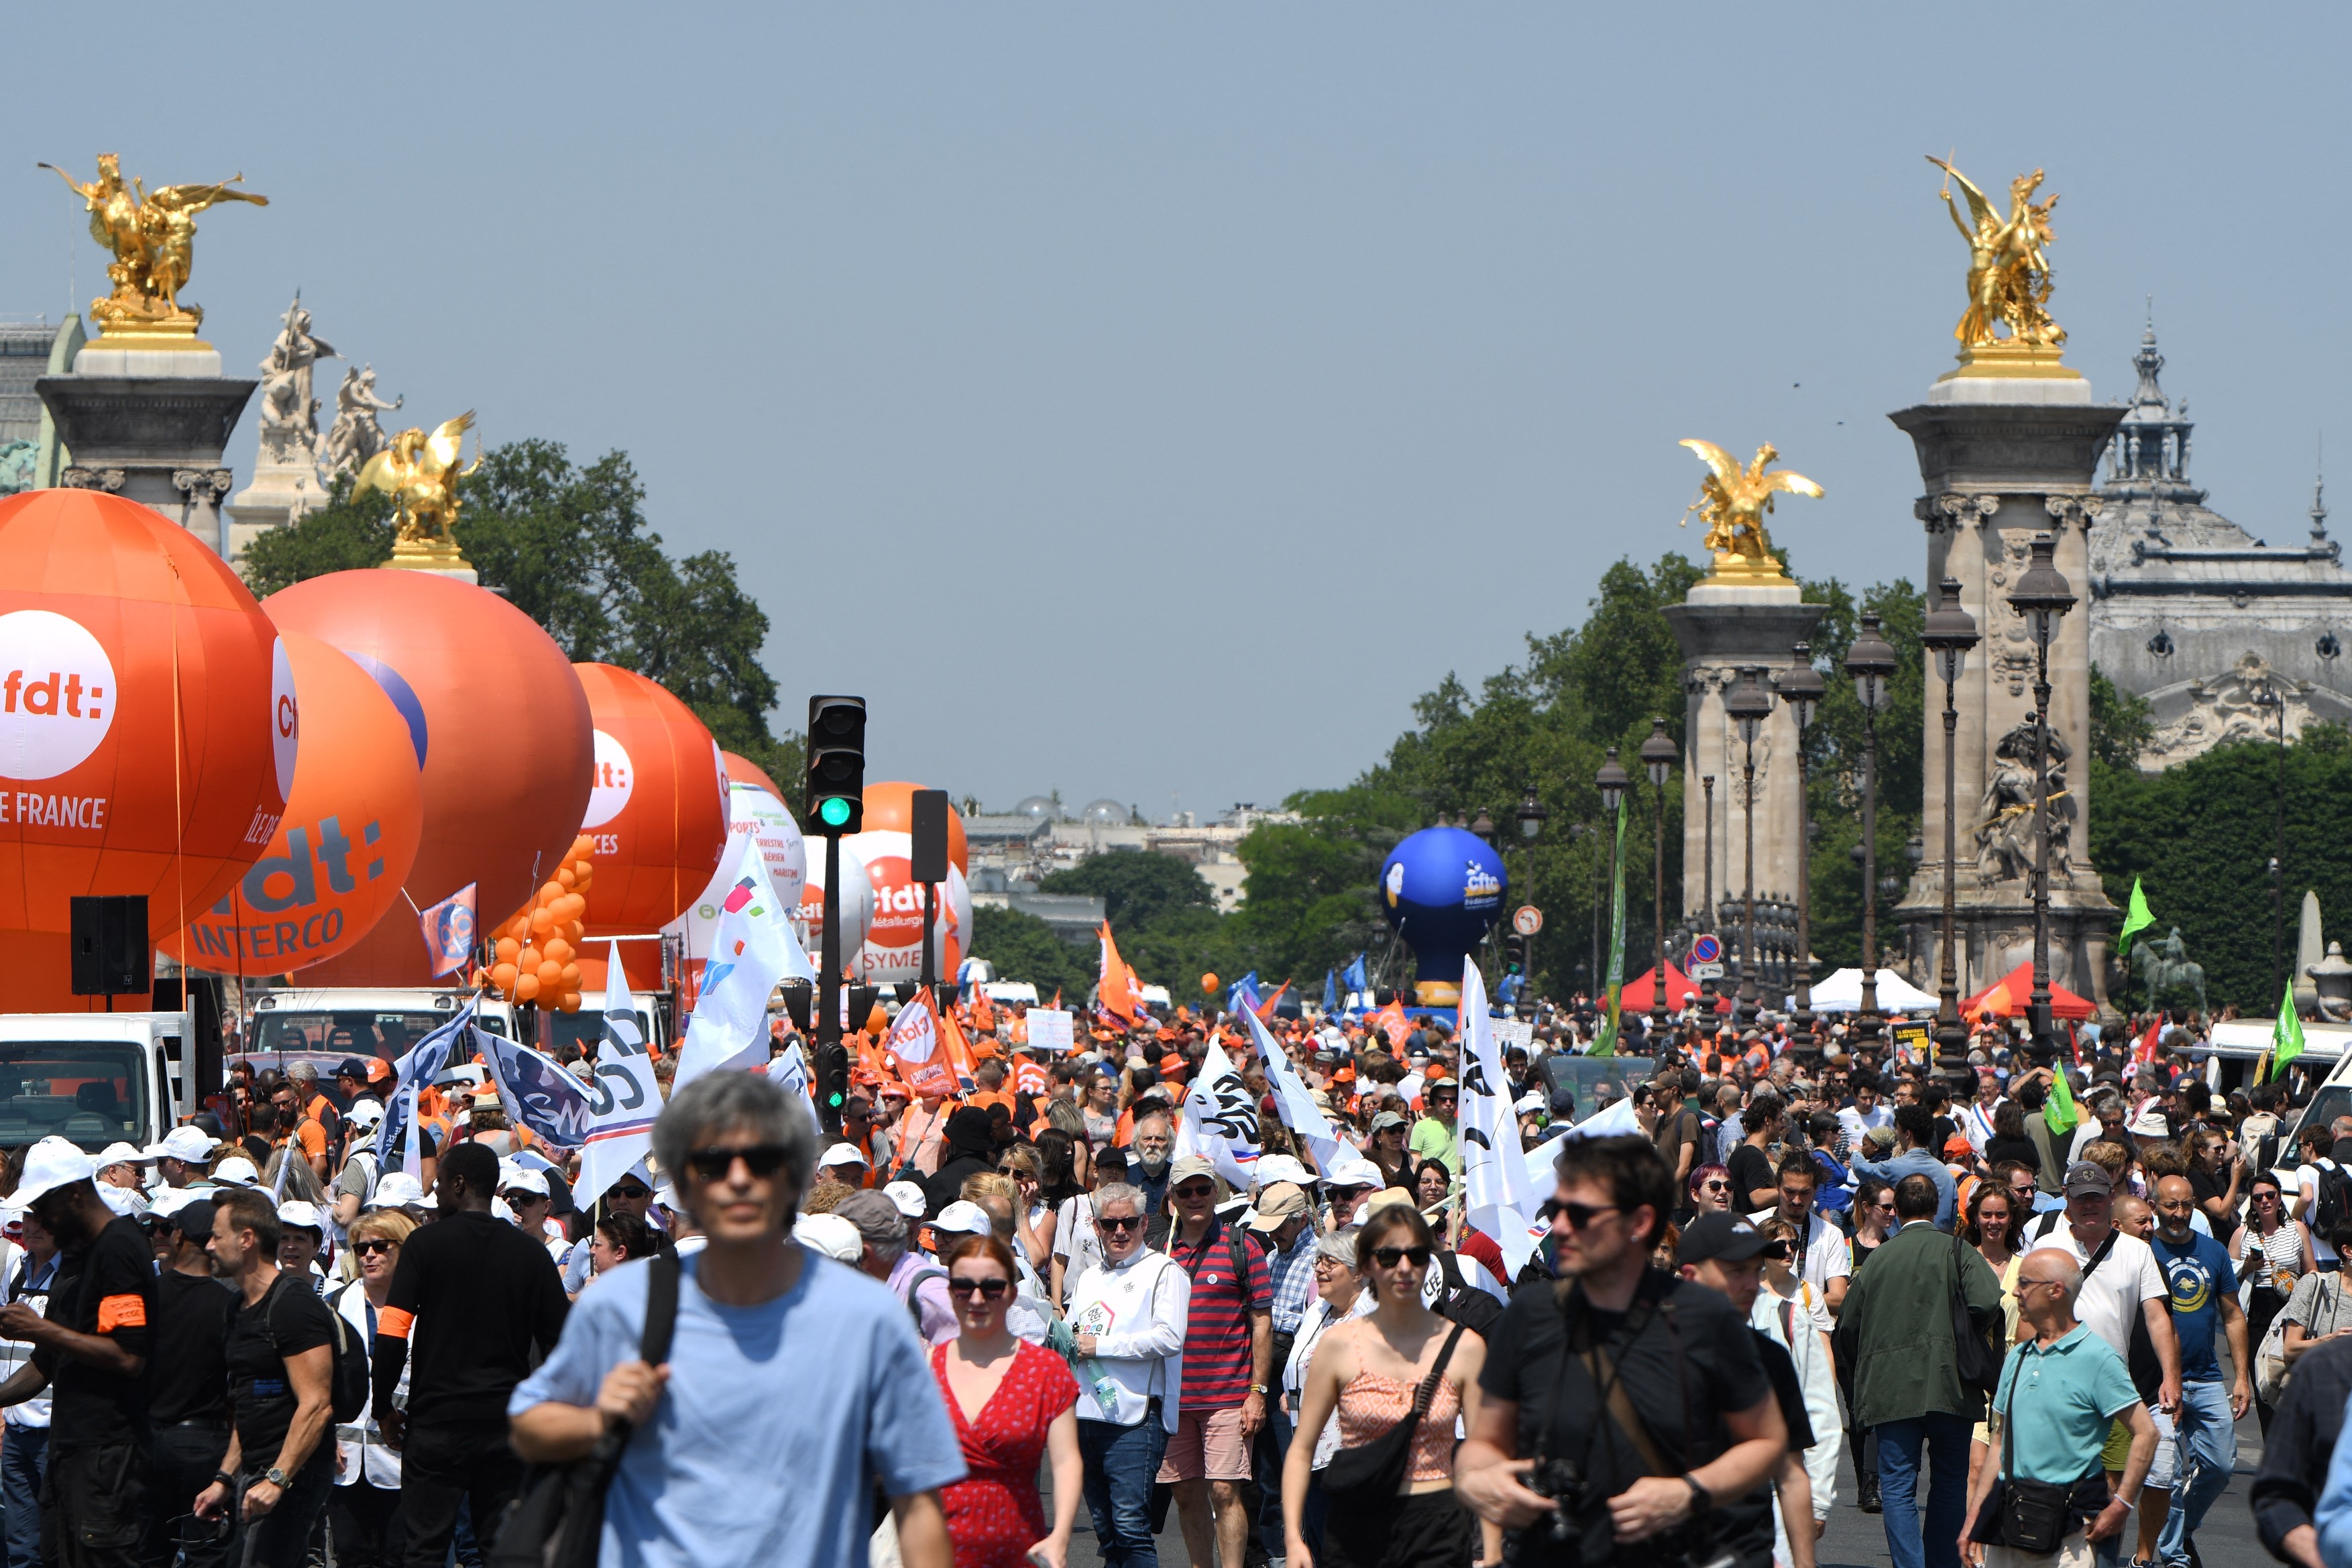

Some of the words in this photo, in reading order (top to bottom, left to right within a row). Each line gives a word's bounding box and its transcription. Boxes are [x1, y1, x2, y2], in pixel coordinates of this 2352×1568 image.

[16, 791, 106, 829] FRANCE
[756, 838, 784, 848] ERRESTRE
[189, 907, 344, 959] INTERCO
[1423, 1270, 1442, 1297] CFE
[1088, 1308, 1101, 1317] CFE
[1090, 1311, 1103, 1321] CGC
